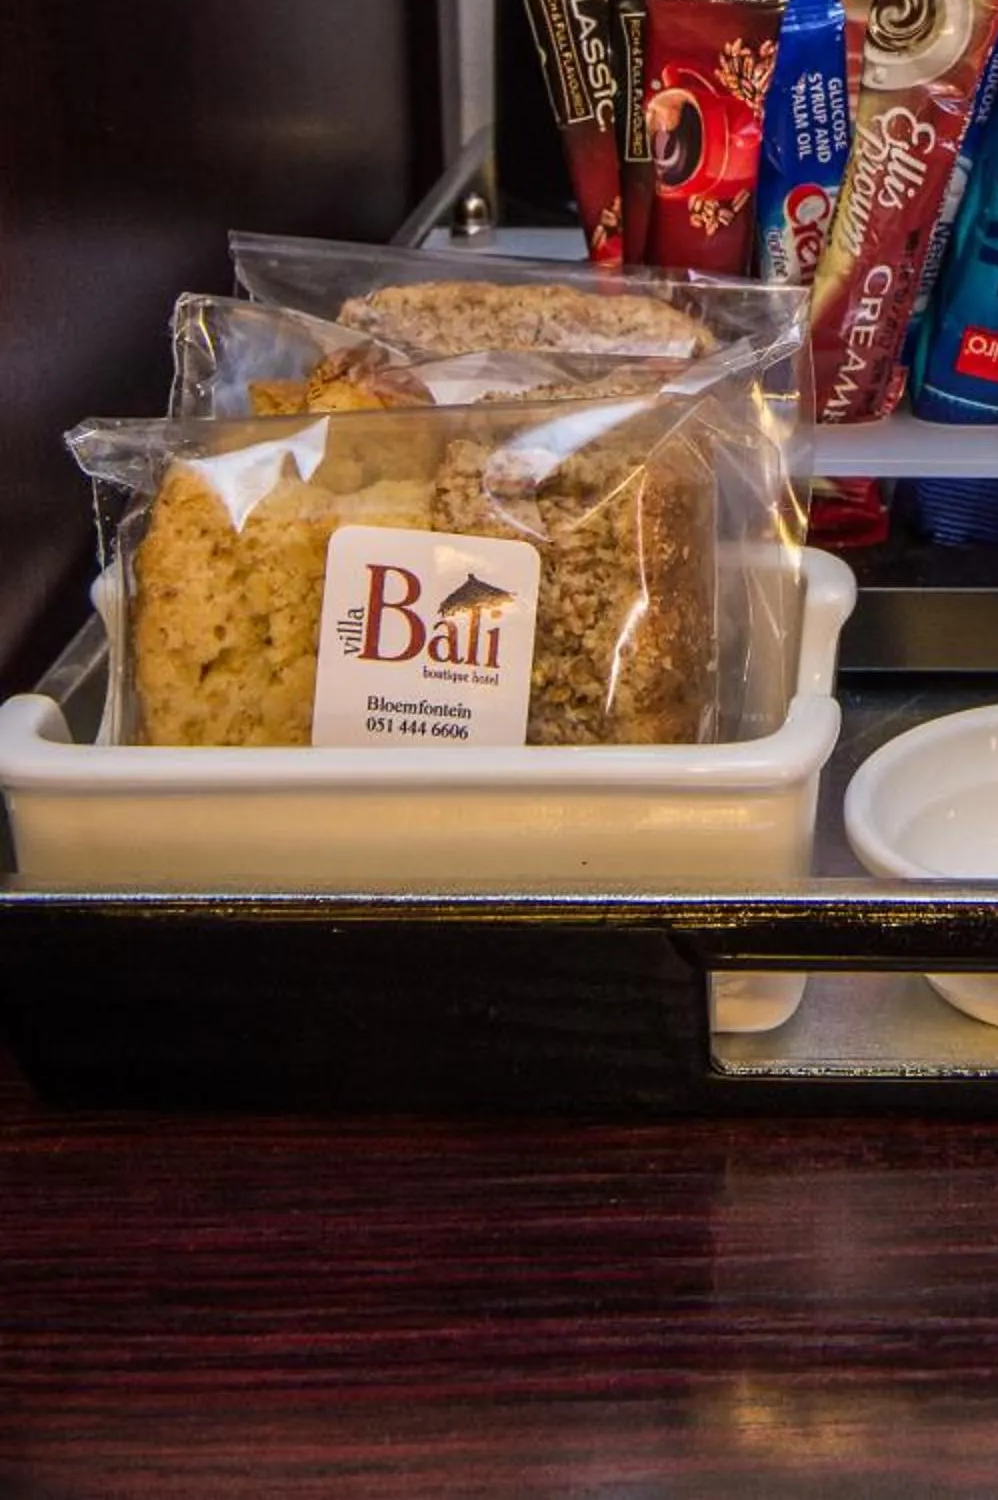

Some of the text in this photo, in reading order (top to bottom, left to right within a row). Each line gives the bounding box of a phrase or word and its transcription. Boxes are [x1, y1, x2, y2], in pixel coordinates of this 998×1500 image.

[553, 22, 569, 52] FULL
[790, 84, 812, 160] PALM OIL
[808, 72, 832, 164] SYRUP AND
[828, 77, 848, 153] GLUCOSE
[872, 106, 936, 209] Ellis
[337, 606, 364, 655] villa
[357, 563, 502, 668] Bali
[423, 665, 499, 685] boutique hotel
[366, 695, 473, 719] Bloemfontein
[366, 717, 469, 740] 051 444 6606
